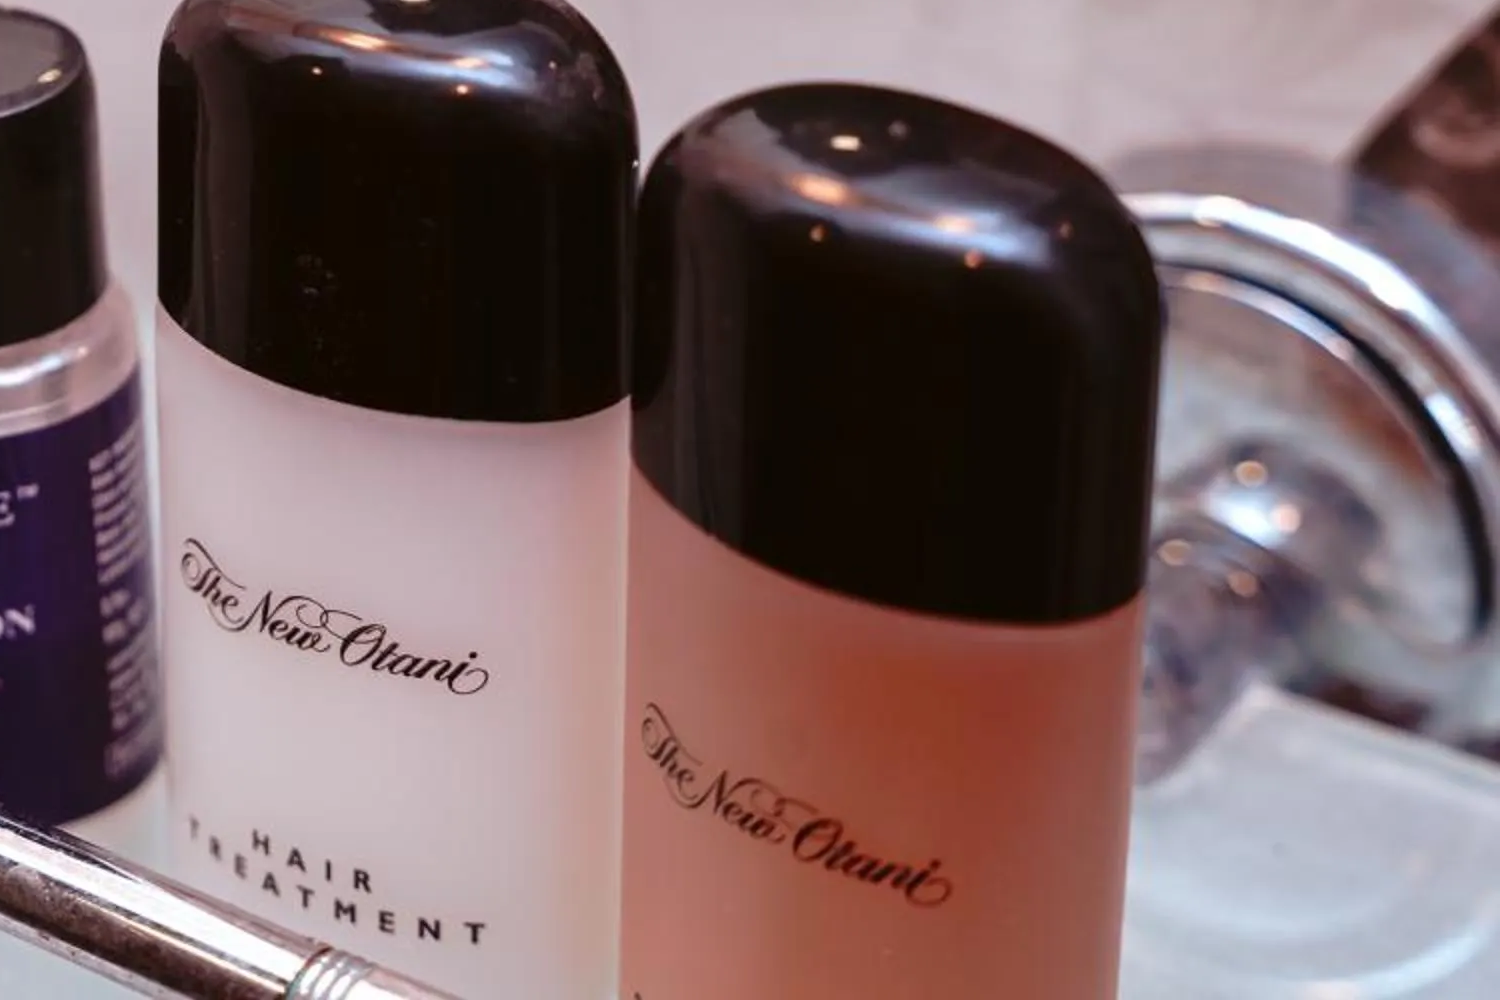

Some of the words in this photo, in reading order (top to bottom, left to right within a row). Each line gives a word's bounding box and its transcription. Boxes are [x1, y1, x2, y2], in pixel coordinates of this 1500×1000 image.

[181, 537, 246, 624] The
[209, 590, 331, 653] New
[322, 609, 489, 695] Otani
[641, 702, 702, 802] The
[664, 770, 786, 844] New
[188, 815, 486, 945] TREATMENT
[251, 829, 373, 893] HAIR
[774, 797, 953, 907] Otani
